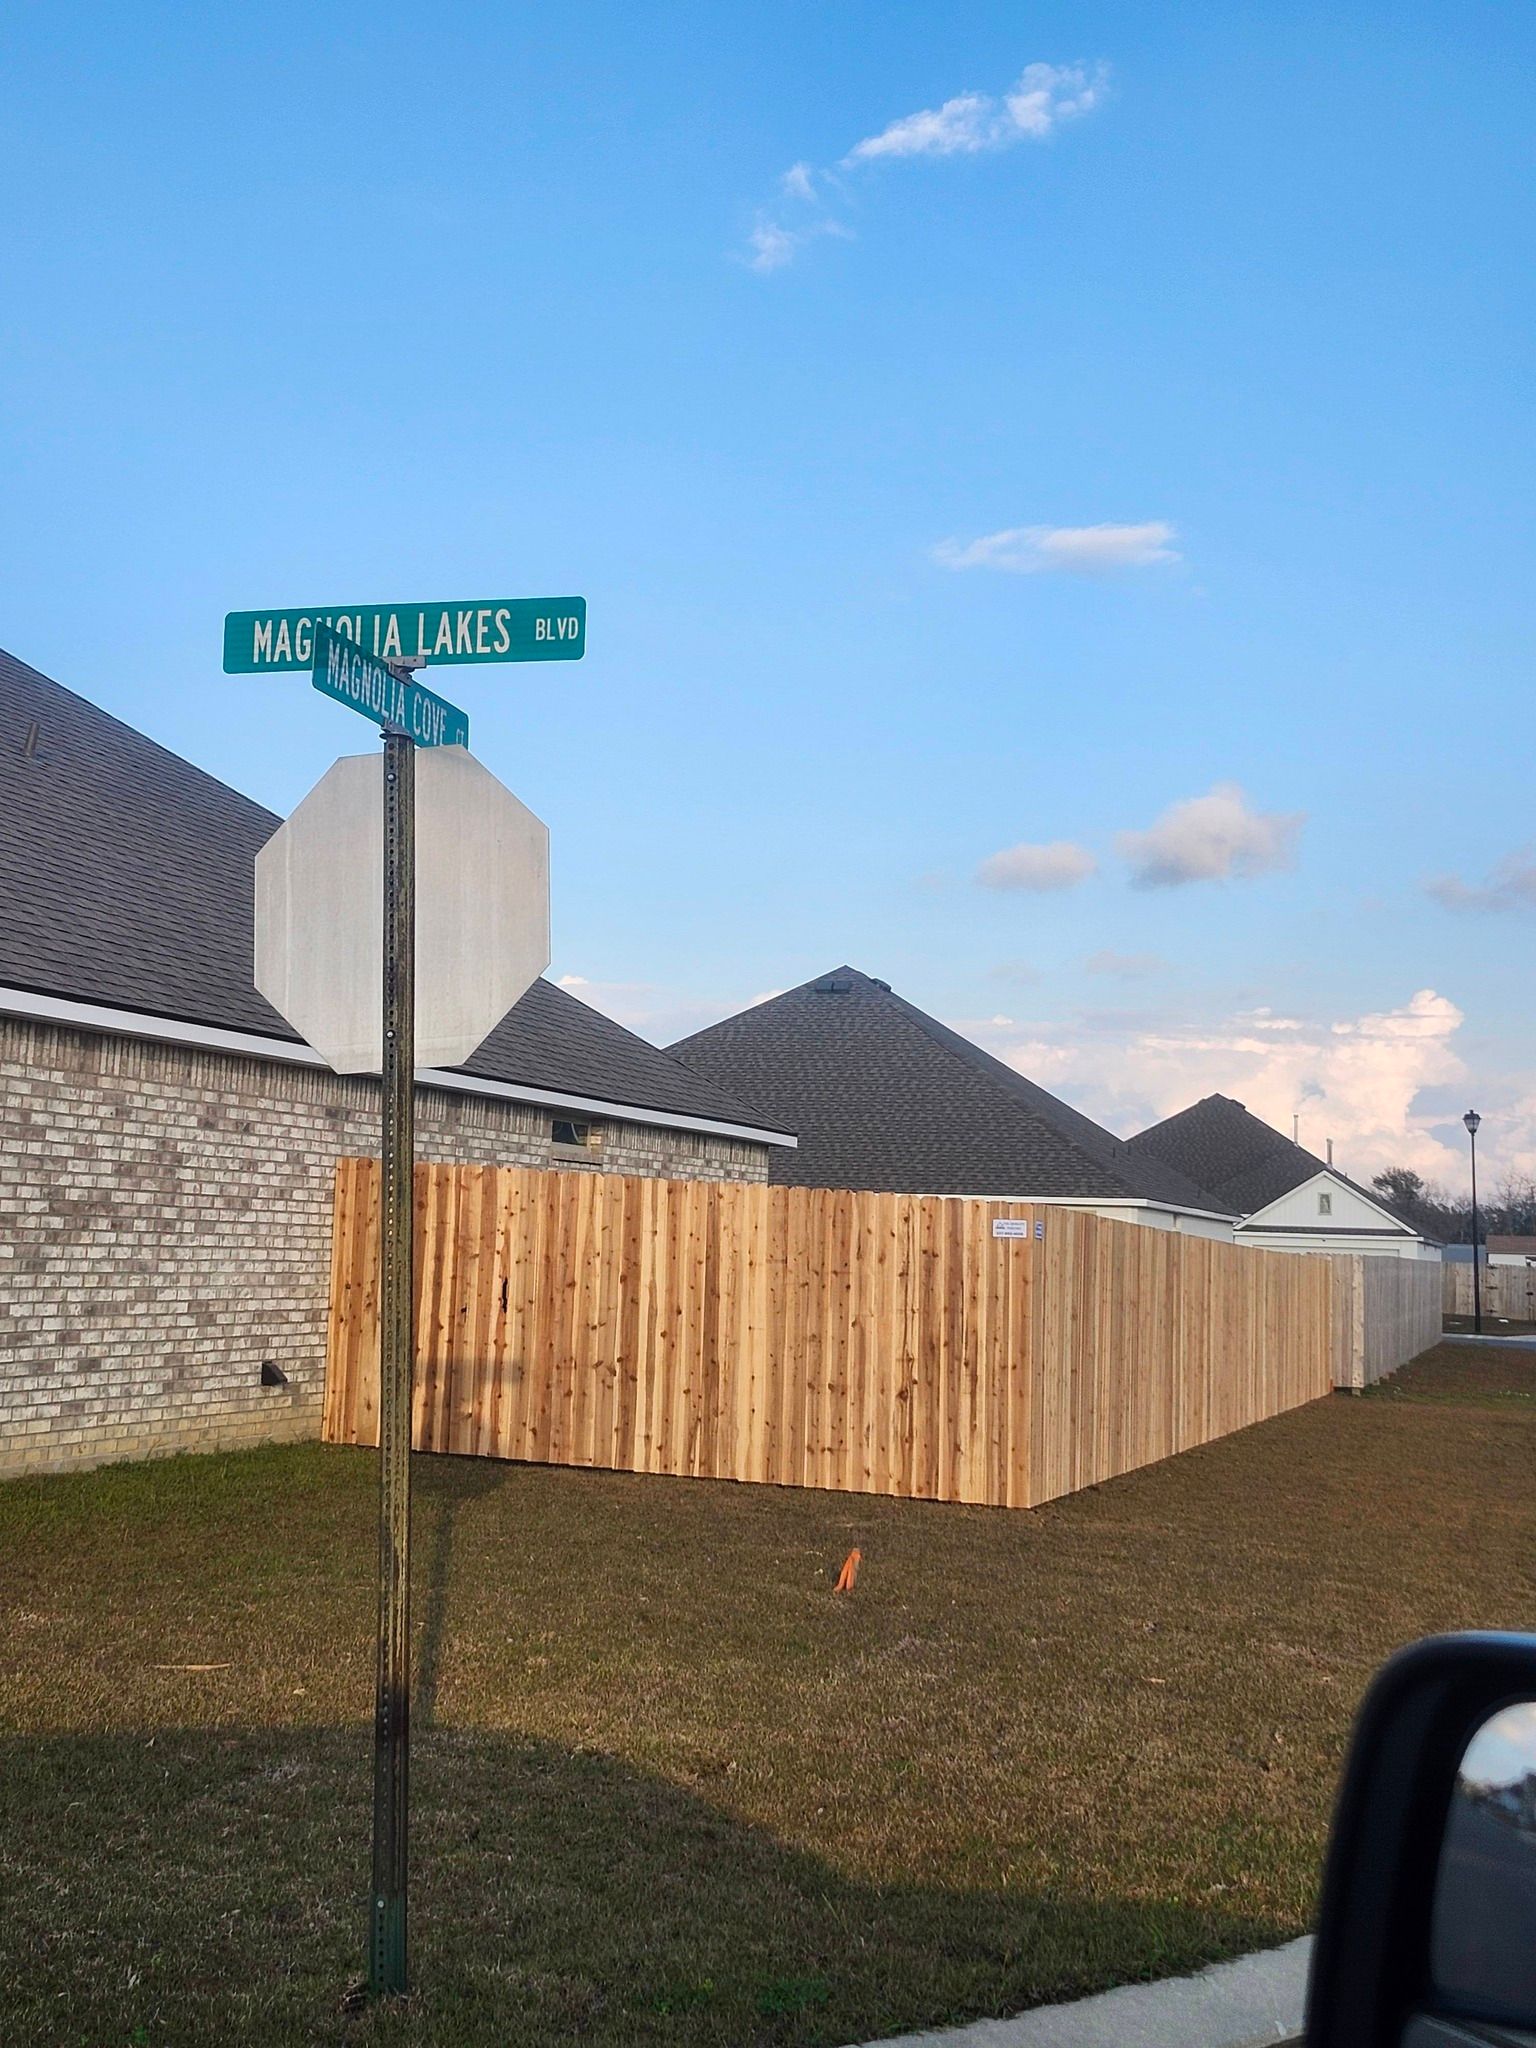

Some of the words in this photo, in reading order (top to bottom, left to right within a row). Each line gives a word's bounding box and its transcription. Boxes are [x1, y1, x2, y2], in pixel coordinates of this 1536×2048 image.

[253, 613, 401, 663] MAGOLIA
[417, 608, 511, 656] LAKES
[535, 617, 579, 641] BLVD
[327, 638, 405, 728] MAGNOLIA
[413, 691, 447, 746] COVE
